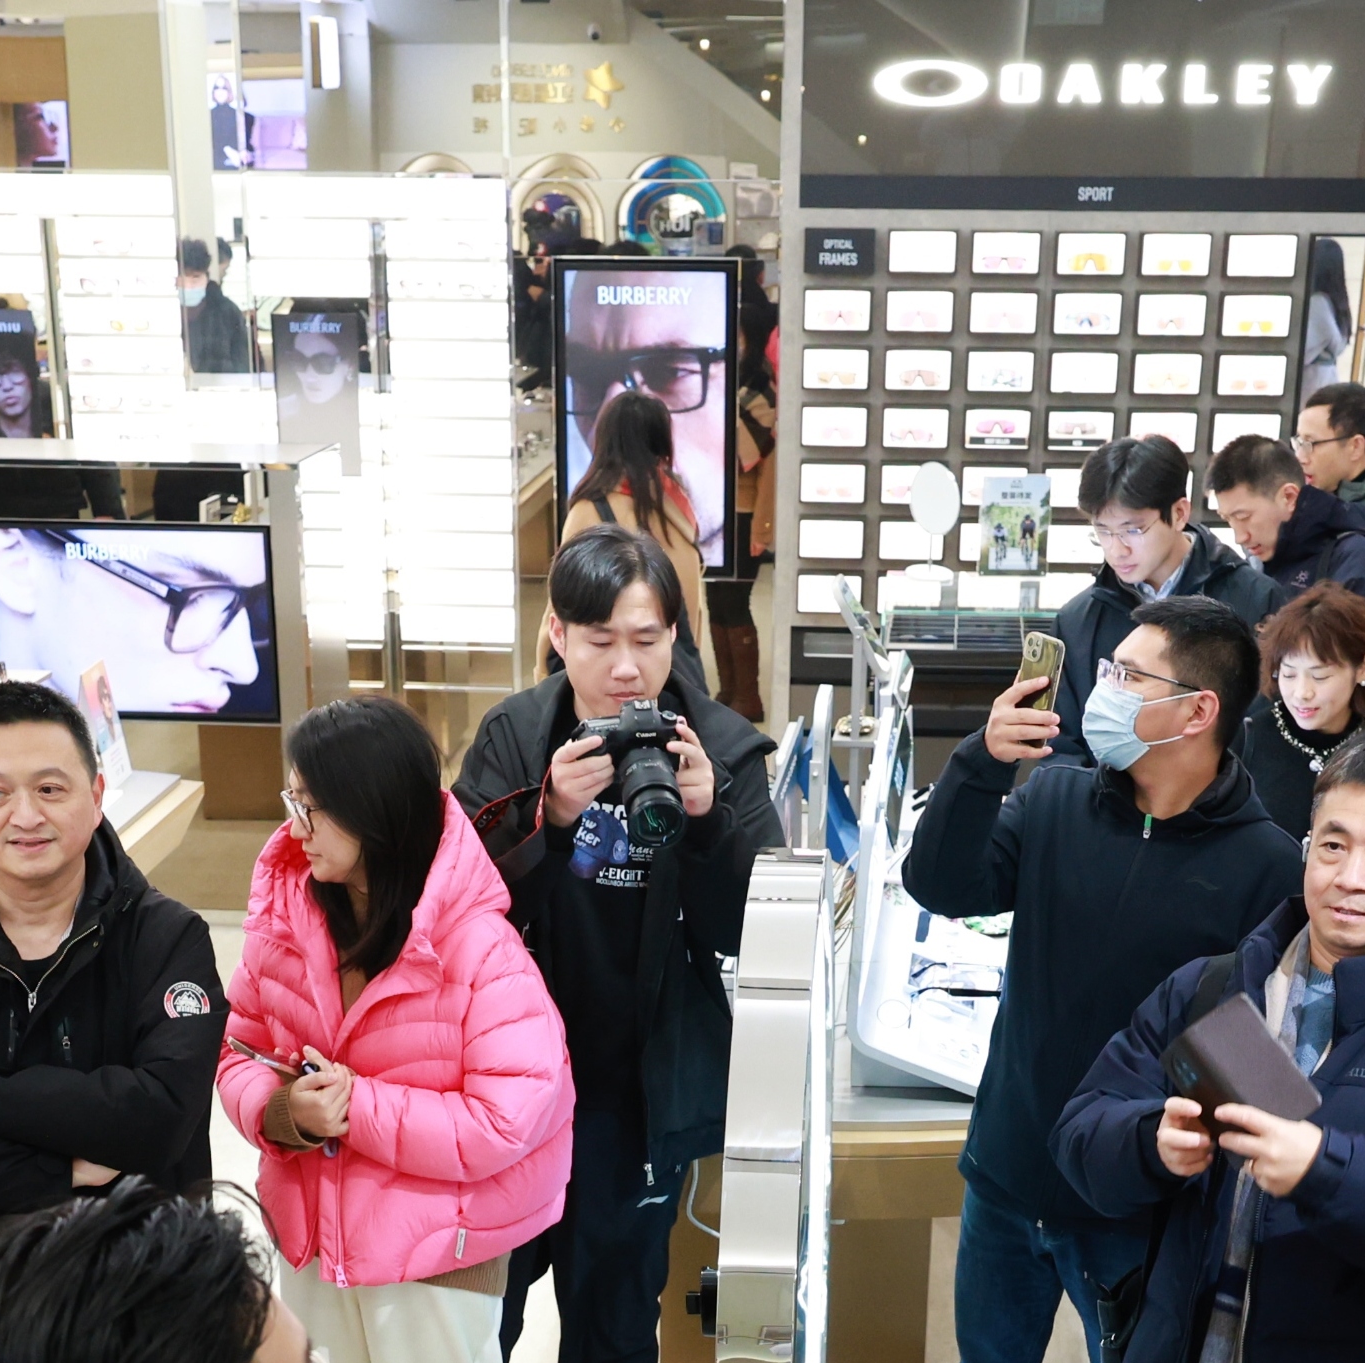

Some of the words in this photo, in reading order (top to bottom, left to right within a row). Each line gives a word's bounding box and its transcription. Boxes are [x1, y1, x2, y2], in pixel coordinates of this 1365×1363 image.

[999, 63, 1333, 105] OAKLEY
[1077, 186, 1114, 202] SPORT
[823, 238, 854, 250] OPTICAL
[818, 252, 858, 266] FRAMES
[597, 285, 692, 306] BURBERRY
[289, 321, 342, 333] BURBERRY
[64, 542, 150, 561] BURBERRY
[576, 826, 601, 847] ker
